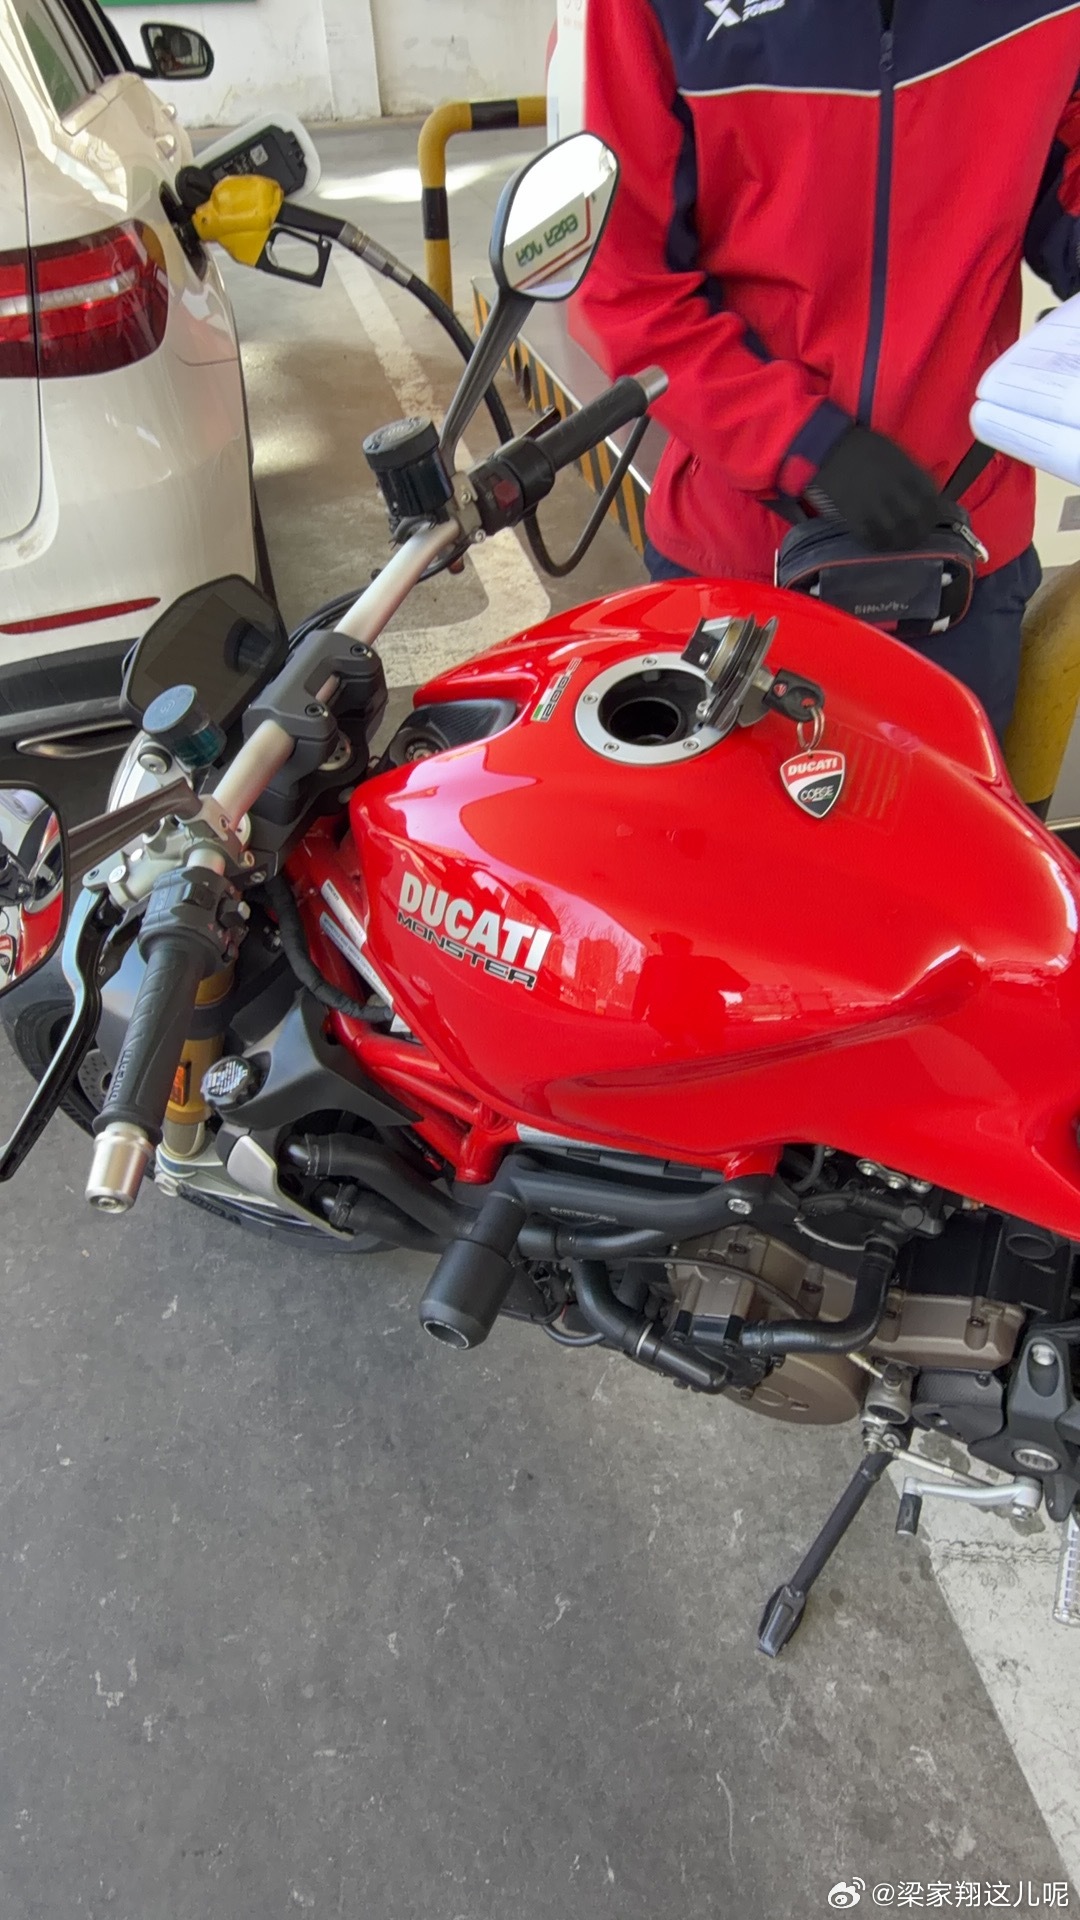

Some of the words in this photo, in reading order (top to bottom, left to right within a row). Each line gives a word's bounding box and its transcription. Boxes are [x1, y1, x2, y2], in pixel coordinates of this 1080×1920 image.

[787, 757, 838, 777] DUCATI
[800, 784, 834, 801] CORSE
[399, 871, 552, 972] DUCATI
[397, 911, 537, 990] MONSTER
